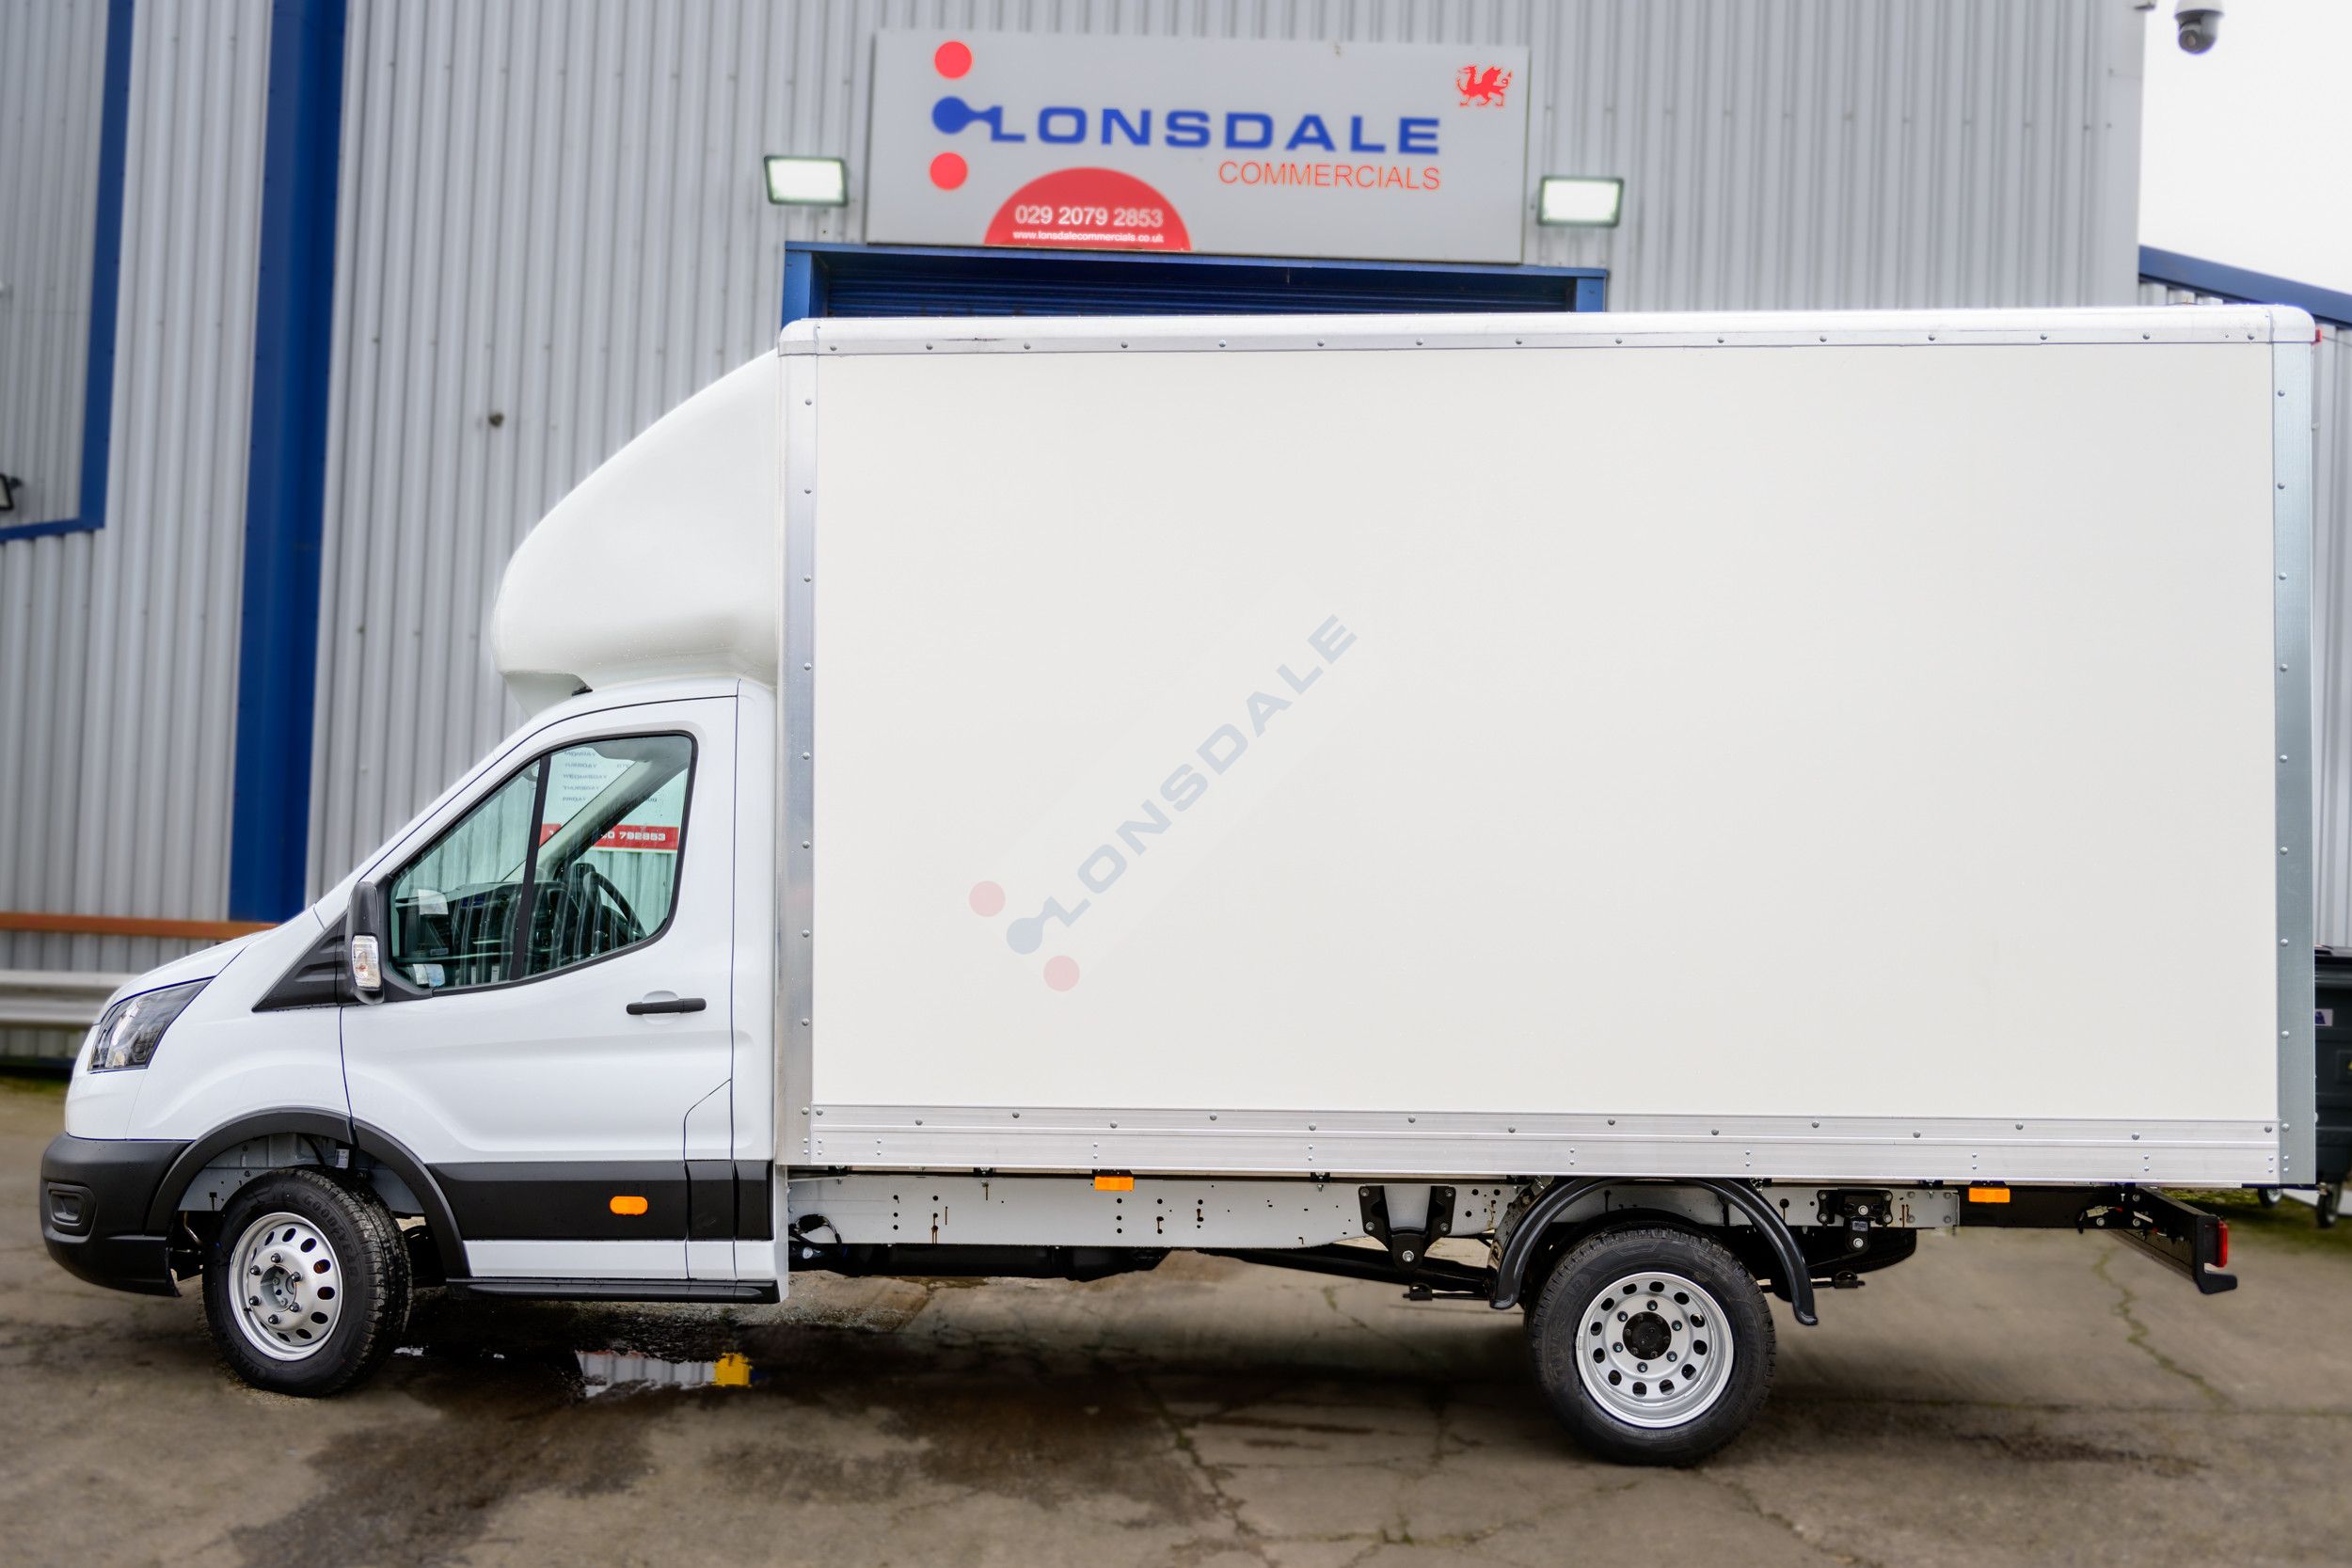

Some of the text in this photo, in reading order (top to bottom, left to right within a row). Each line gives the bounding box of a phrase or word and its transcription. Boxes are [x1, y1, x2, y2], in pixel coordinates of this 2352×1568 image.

[990, 105, 1440, 155] LONSDALE
[1217, 161, 1441, 190] COMMERCIALS
[1015, 204, 1164, 228] 029 2079 2853
[1012, 230, 1165, 244] www.lonsdalecommercials.co.uk
